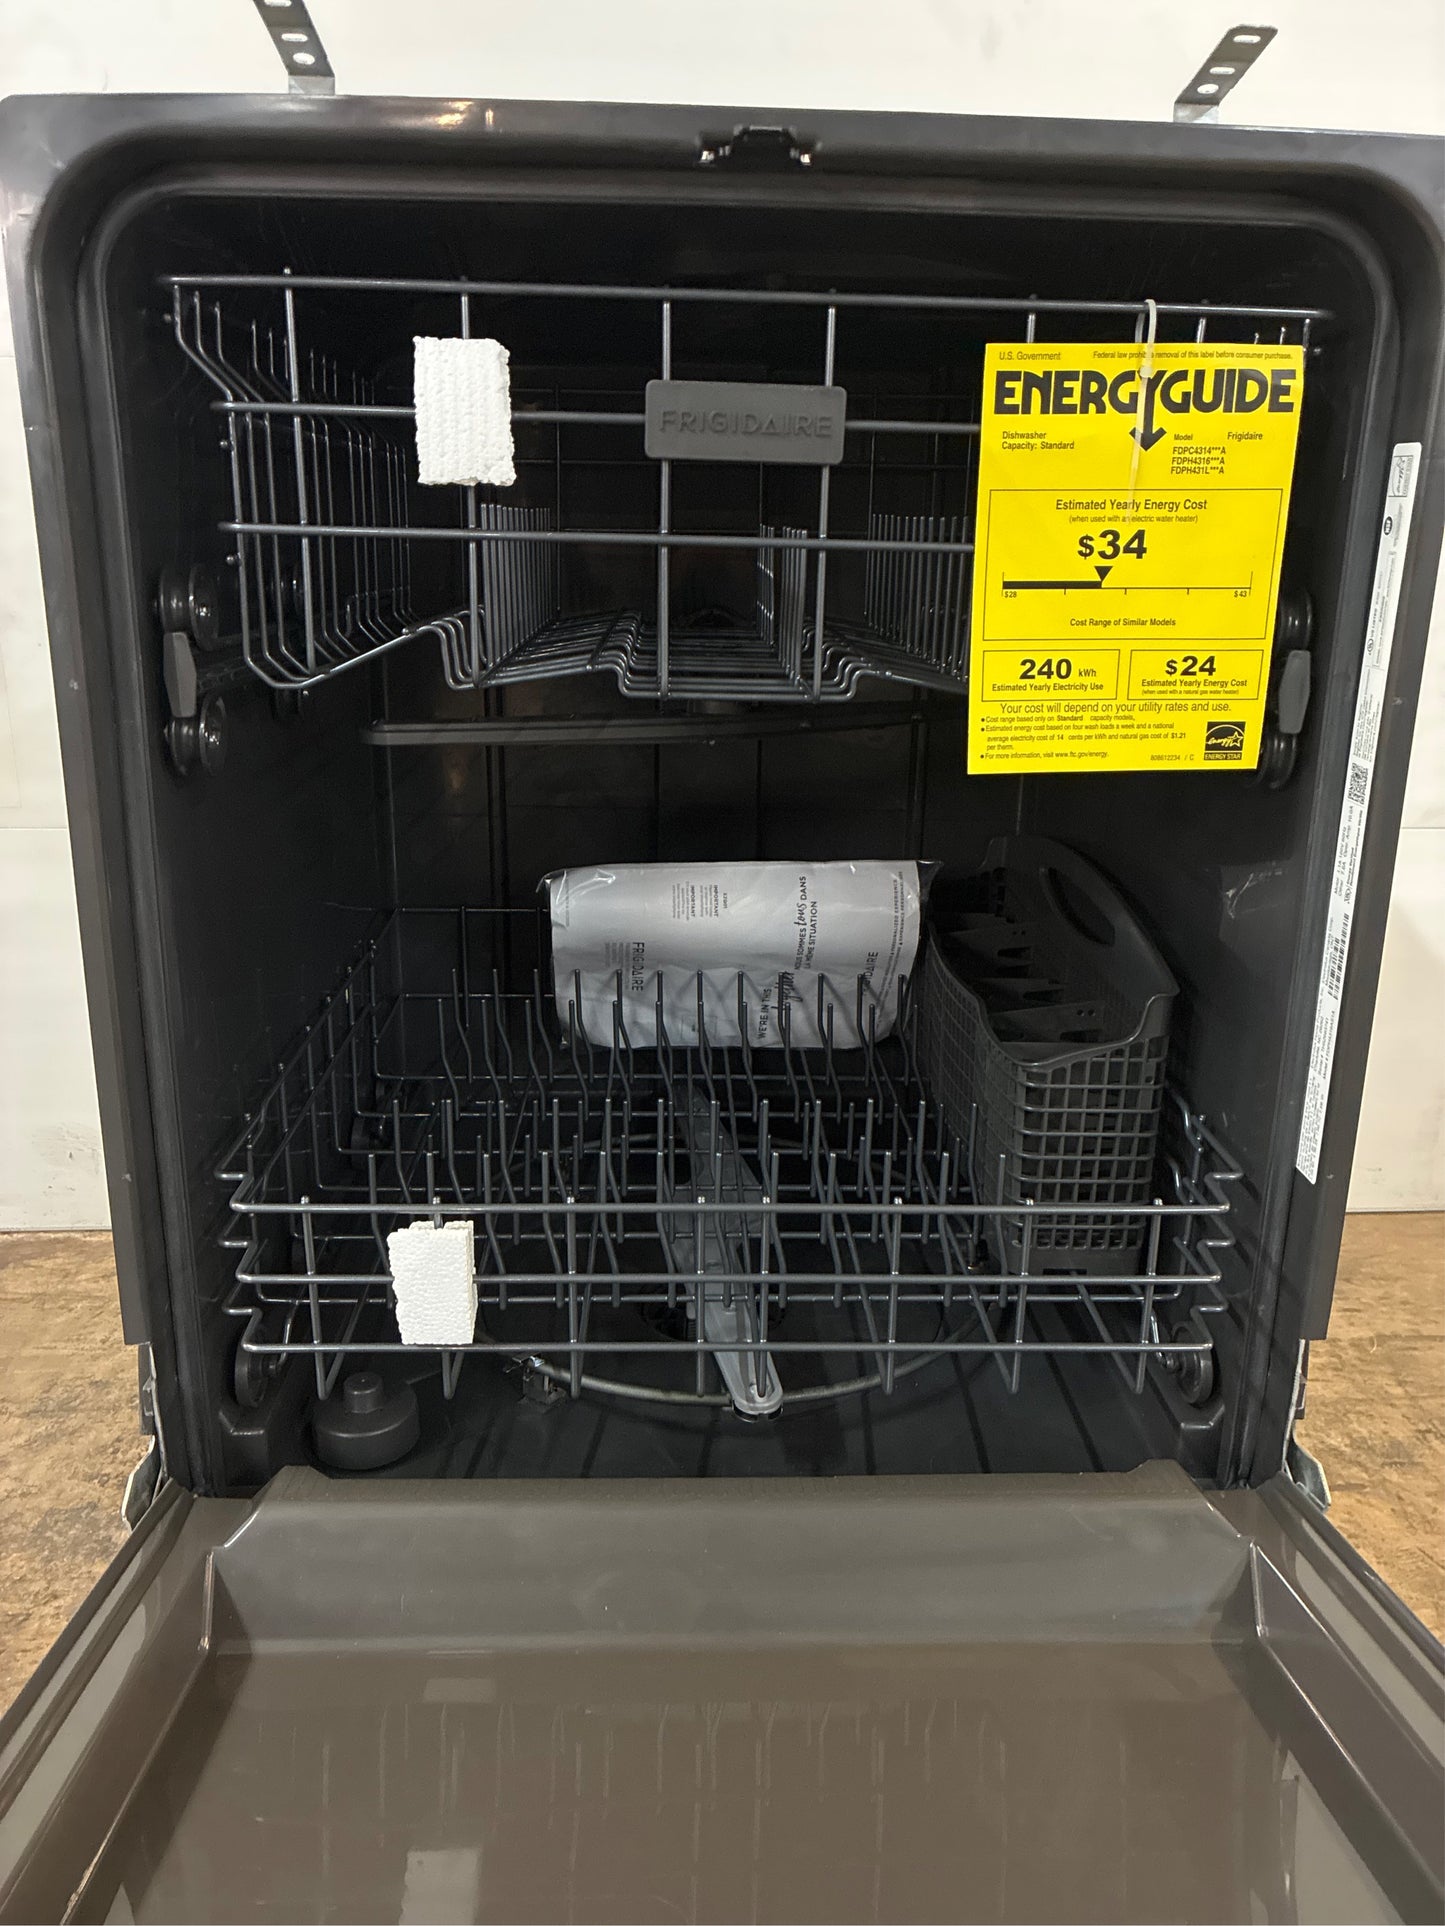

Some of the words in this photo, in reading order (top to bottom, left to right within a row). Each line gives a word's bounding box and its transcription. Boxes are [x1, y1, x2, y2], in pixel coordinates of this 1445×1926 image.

[1000, 352, 1014, 360] U.S.
[1017, 352, 1061, 360] Government
[994, 370, 1296, 414] ENERGYGUIDE
[660, 410, 833, 438] FRIGIDAIRE
[1002, 431, 1046, 439] Dishwasher
[1228, 432, 1263, 442] Frigidaire
[1002, 442, 1038, 451] Capacity:
[1040, 441, 1074, 450] Standard
[1056, 499, 1106, 510] Estimated
[1110, 499, 1141, 512] Yearly
[1144, 499, 1180, 512] Energy
[1184, 499, 1208, 510] Cost
[1069, 515, 1089, 523] (when
[1090, 515, 1106, 523] used
[1107, 515, 1120, 523] with
[1131, 515, 1154, 523] electric
[1156, 515, 1174, 523] water
[1174, 515, 1198, 523] heater)
[1078, 529, 1148, 560] $34
[1070, 618, 1086, 626] Cost
[1088, 618, 1112, 628] Range
[1114, 618, 1122, 626] of
[1122, 618, 1147, 626] Similar
[1150, 618, 1176, 626] Models
[1019, 658, 1072, 680] 240
[1078, 668, 1096, 677] kWh
[1165, 656, 1216, 676] $24
[1029, 684, 1050, 692] Yearly
[1053, 682, 1088, 692] Electricity
[1090, 682, 1104, 690] Use
[1179, 679, 1201, 688] Yearly
[1204, 679, 1228, 688] Energy
[1000, 704, 1022, 713] Your
[1024, 704, 1044, 713] cost
[1046, 702, 1060, 712] will
[1064, 702, 1099, 714] depend
[1101, 704, 1112, 712] on
[1116, 704, 1136, 714] your
[1138, 702, 1162, 714] utility
[1165, 702, 1188, 712] rates
[1191, 702, 1210, 712] and
[1212, 703, 1232, 712] use.
[798, 876, 807, 900] DANS
[794, 902, 808, 926] tous
[808, 901, 818, 946] SITUATION
[796, 928, 806, 956] SOMMES
[632, 942, 645, 992] FRIGIDAIRE
[762, 988, 772, 1002] THIS
[760, 1004, 770, 1013] IN
[757, 1014, 768, 1039] WE'RE
